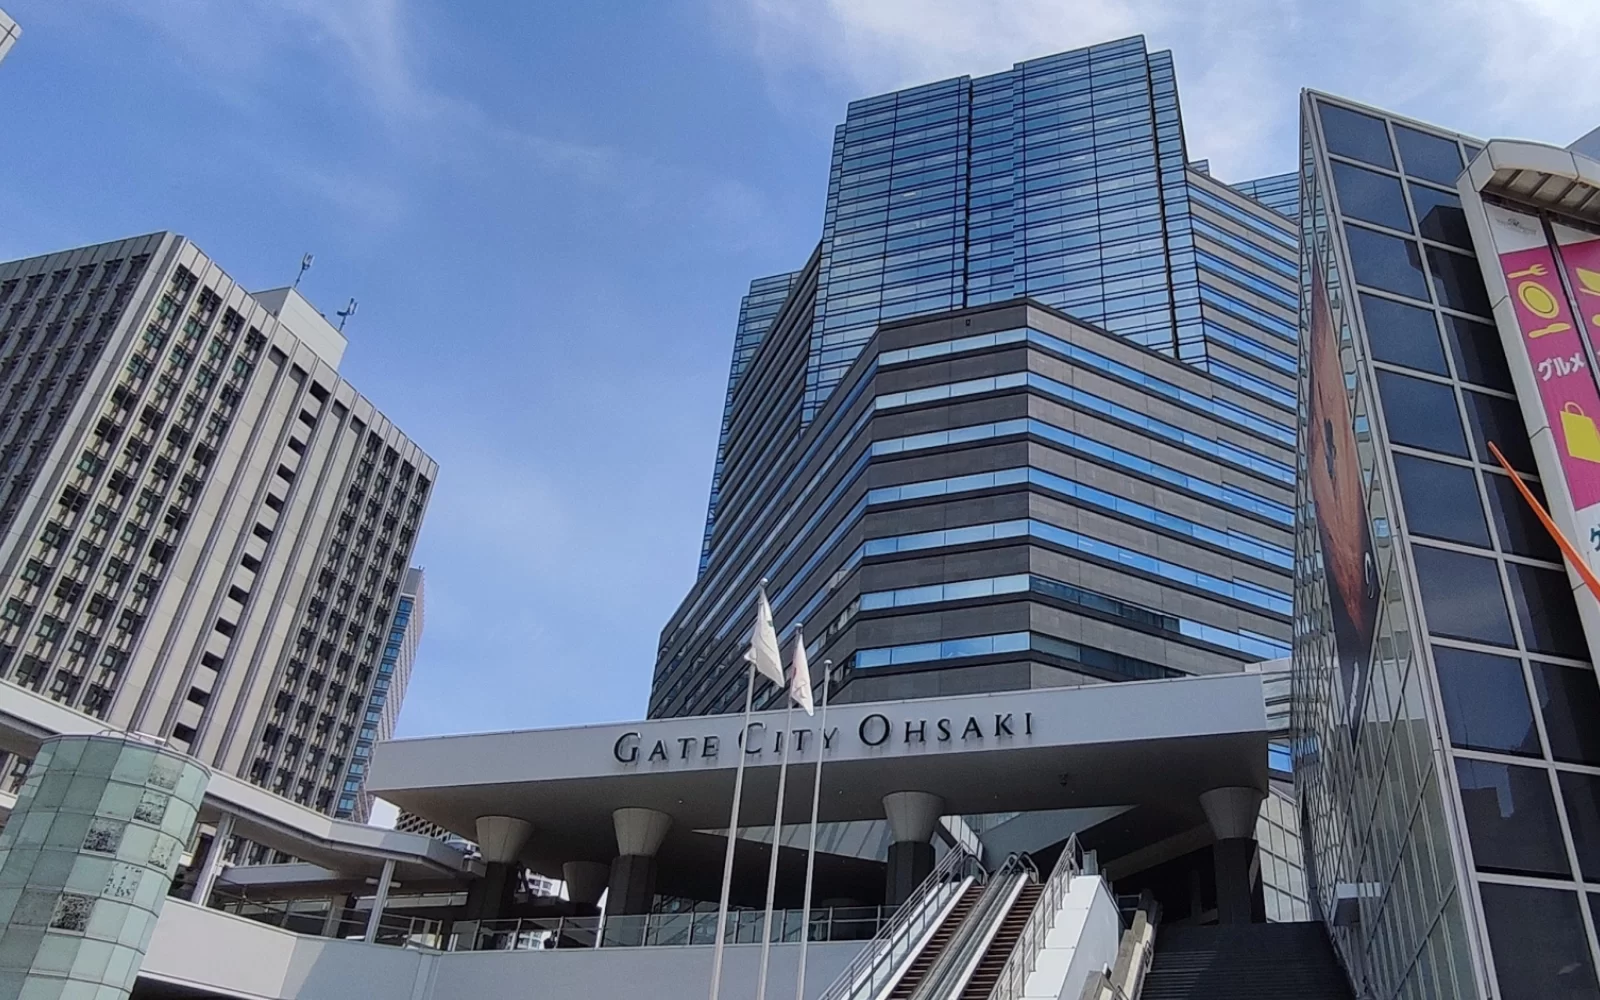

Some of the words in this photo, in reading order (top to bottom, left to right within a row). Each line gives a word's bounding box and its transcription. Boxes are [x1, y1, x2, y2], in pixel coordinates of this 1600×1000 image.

[1537, 352, 1585, 382] グルメ
[613, 731, 720, 764] GATE
[738, 721, 838, 755] CITY
[858, 712, 1032, 747] OHSAKI
